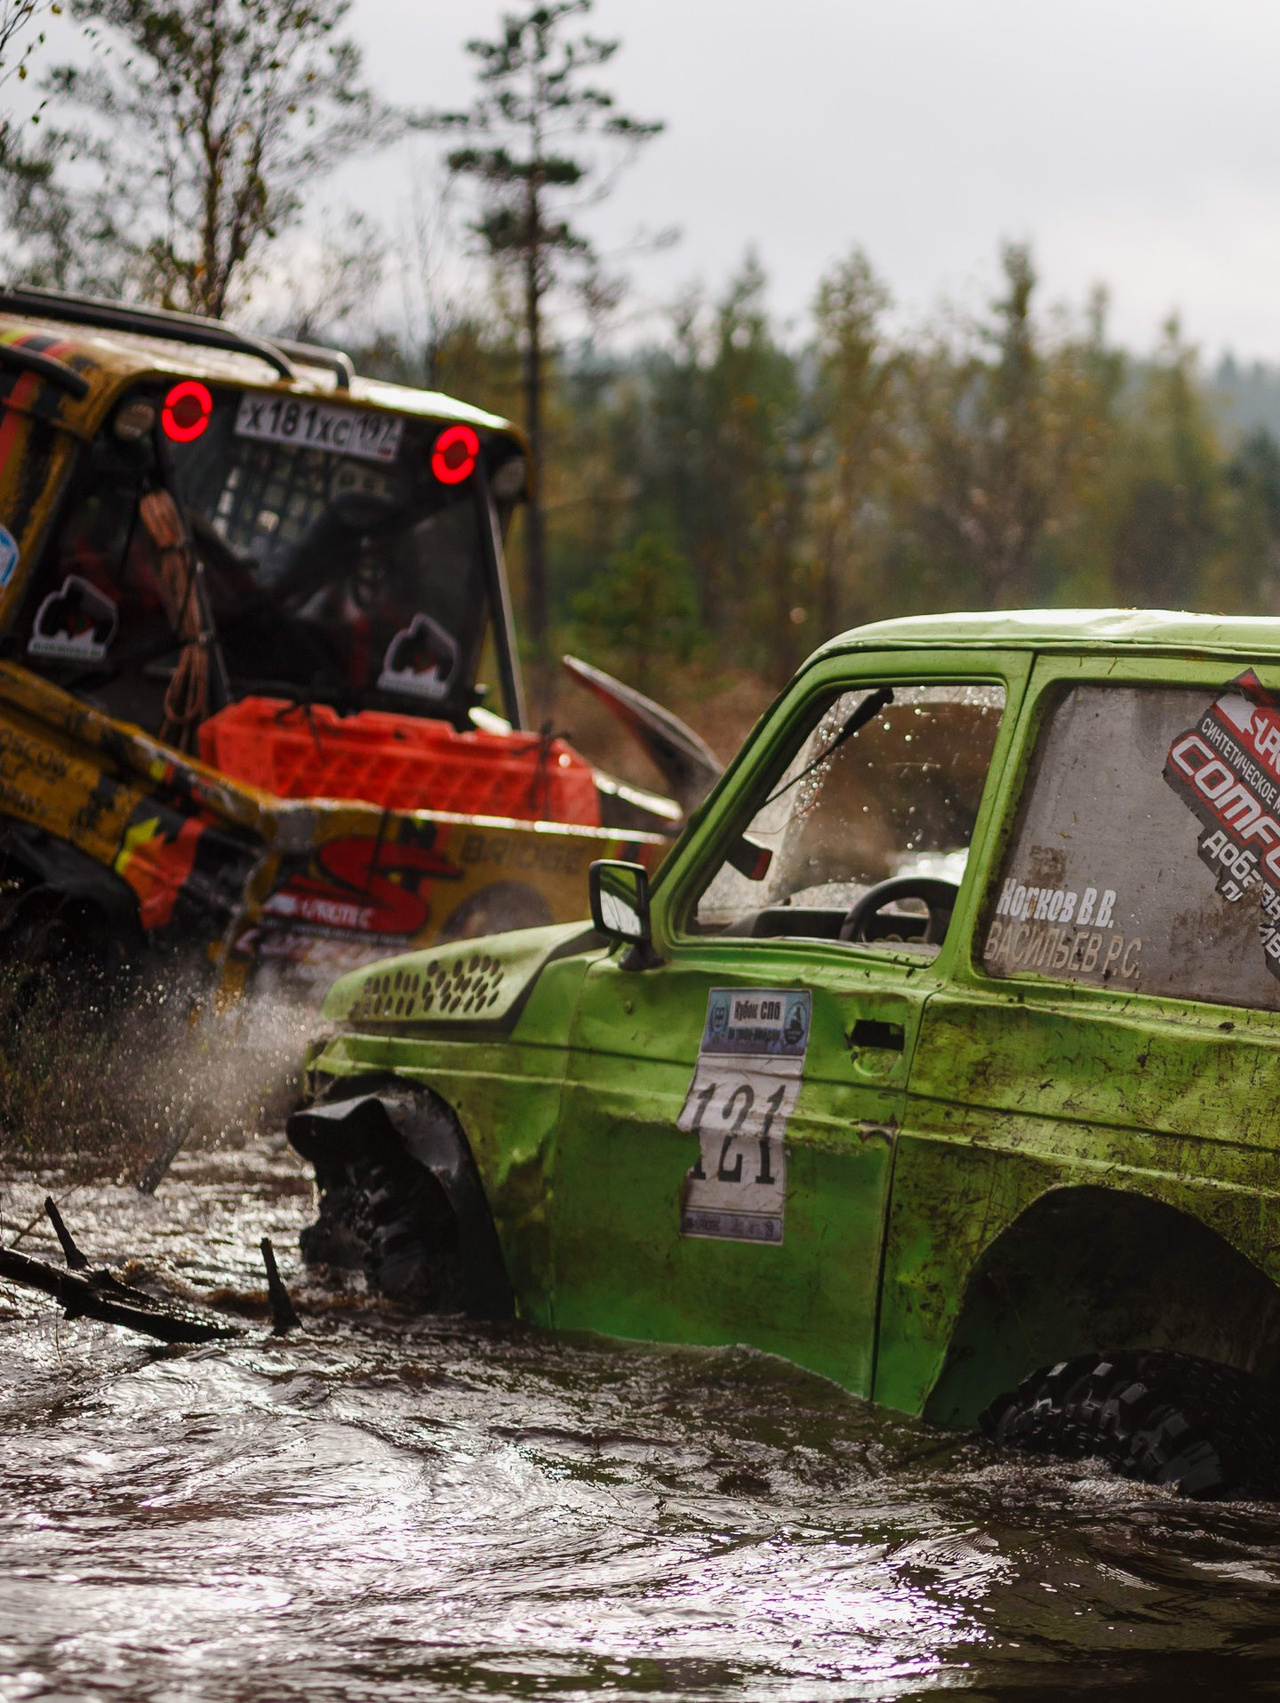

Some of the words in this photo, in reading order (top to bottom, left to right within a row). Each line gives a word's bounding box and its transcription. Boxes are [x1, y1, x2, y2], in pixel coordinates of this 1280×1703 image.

[1202, 718, 1277, 804] СИНТЕТИЧЕСКОЕ
[734, 1000, 758, 1021] Кубок
[760, 1000, 781, 1020] СПб
[689, 1082, 786, 1185] 121
